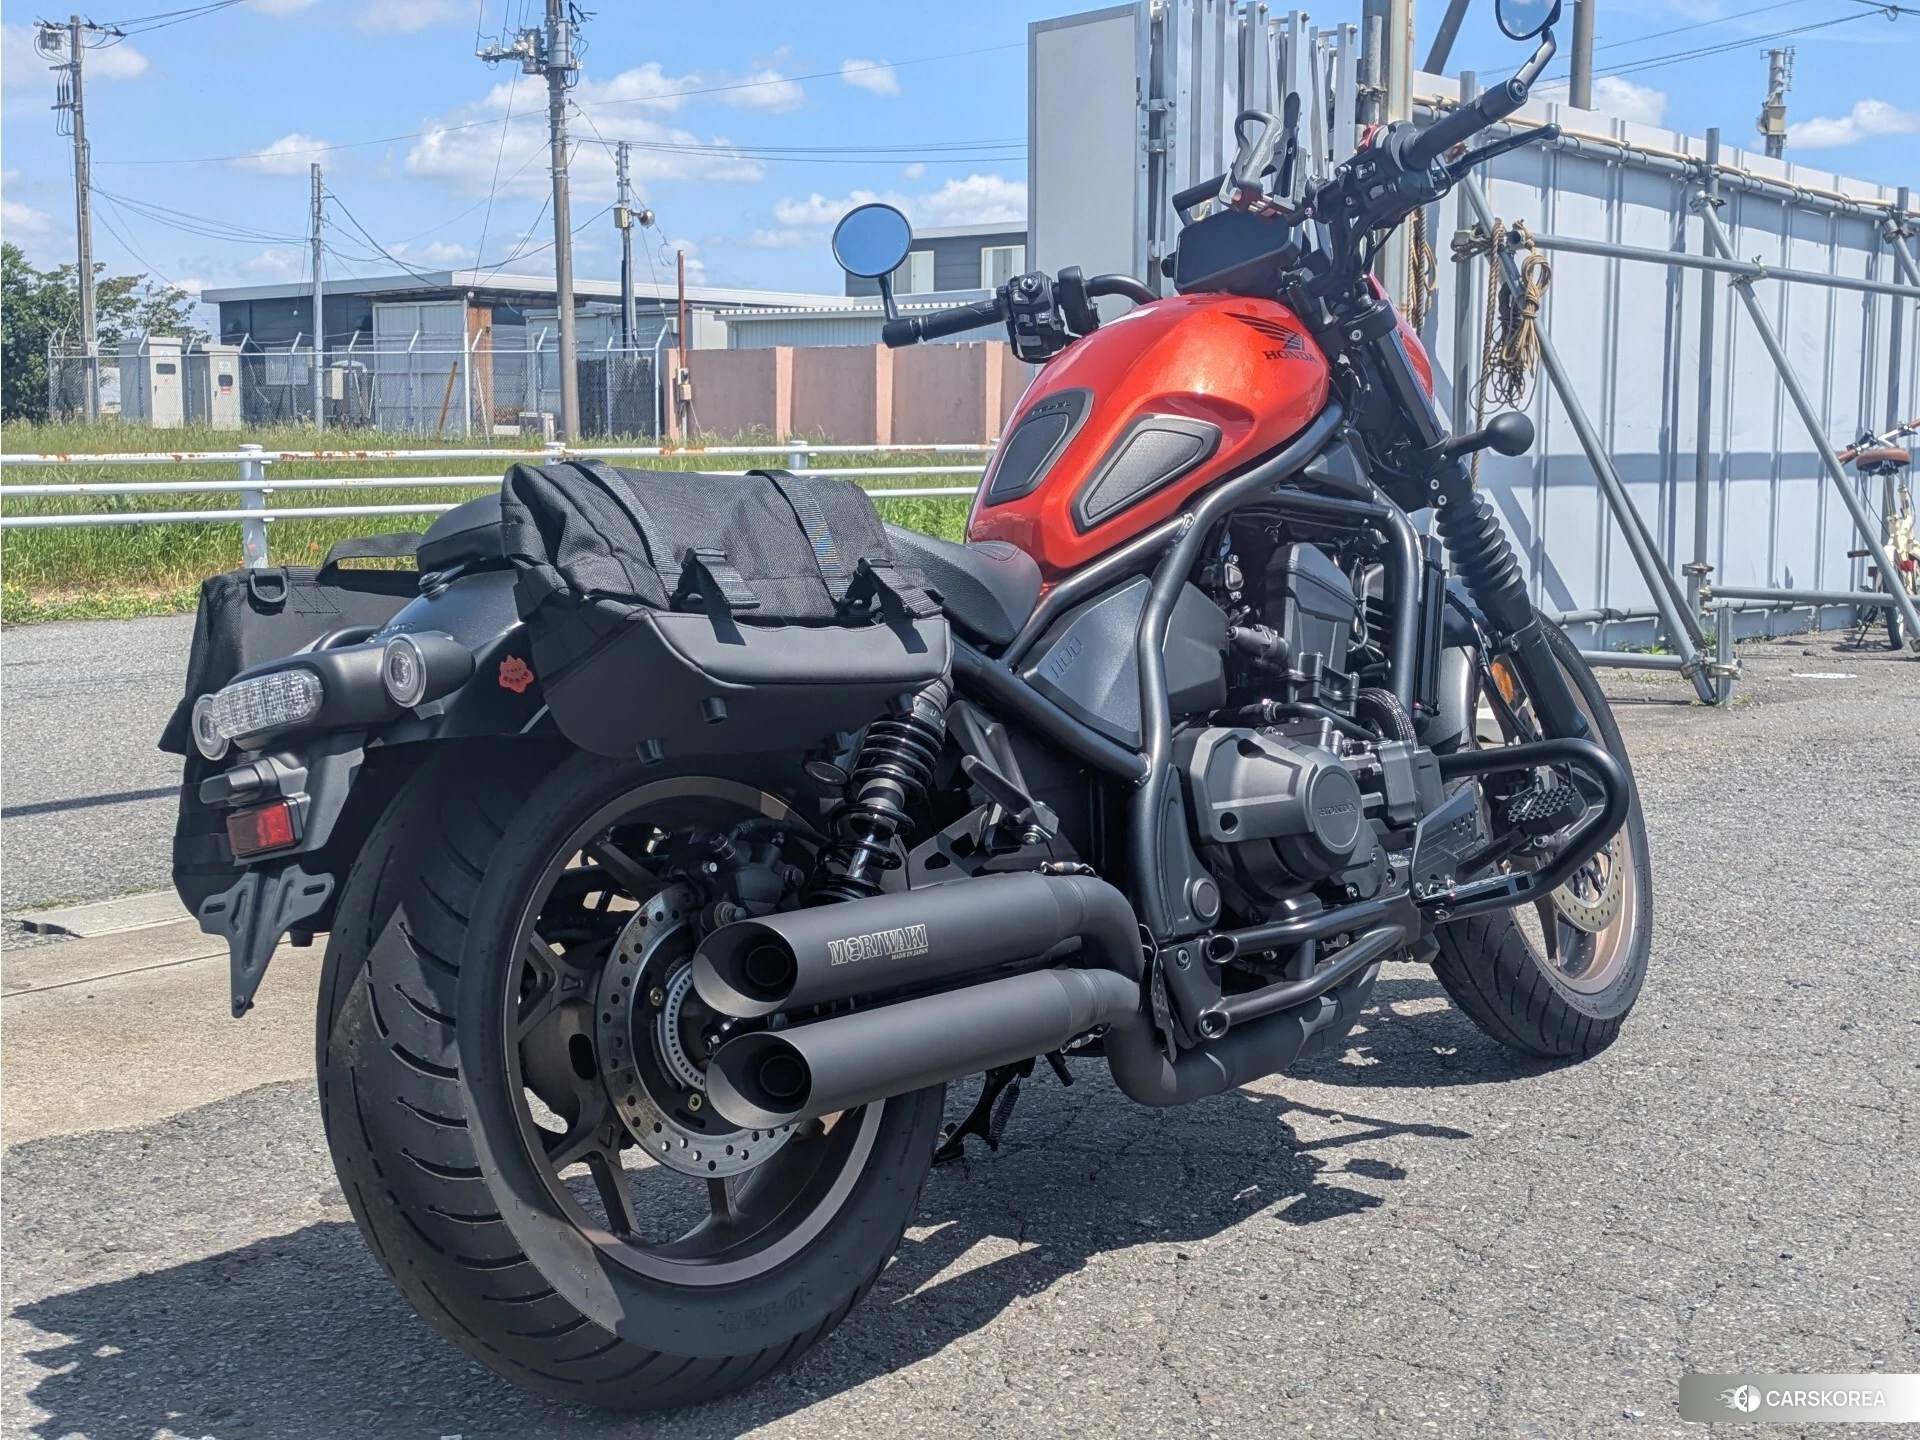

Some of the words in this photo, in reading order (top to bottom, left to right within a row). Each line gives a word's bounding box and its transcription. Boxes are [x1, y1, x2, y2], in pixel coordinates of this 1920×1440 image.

[1262, 350, 1317, 362] HONDA
[1319, 803, 1357, 816] HONDA
[827, 923, 929, 966] MORIWAKI
[891, 952, 906, 961] MADE
